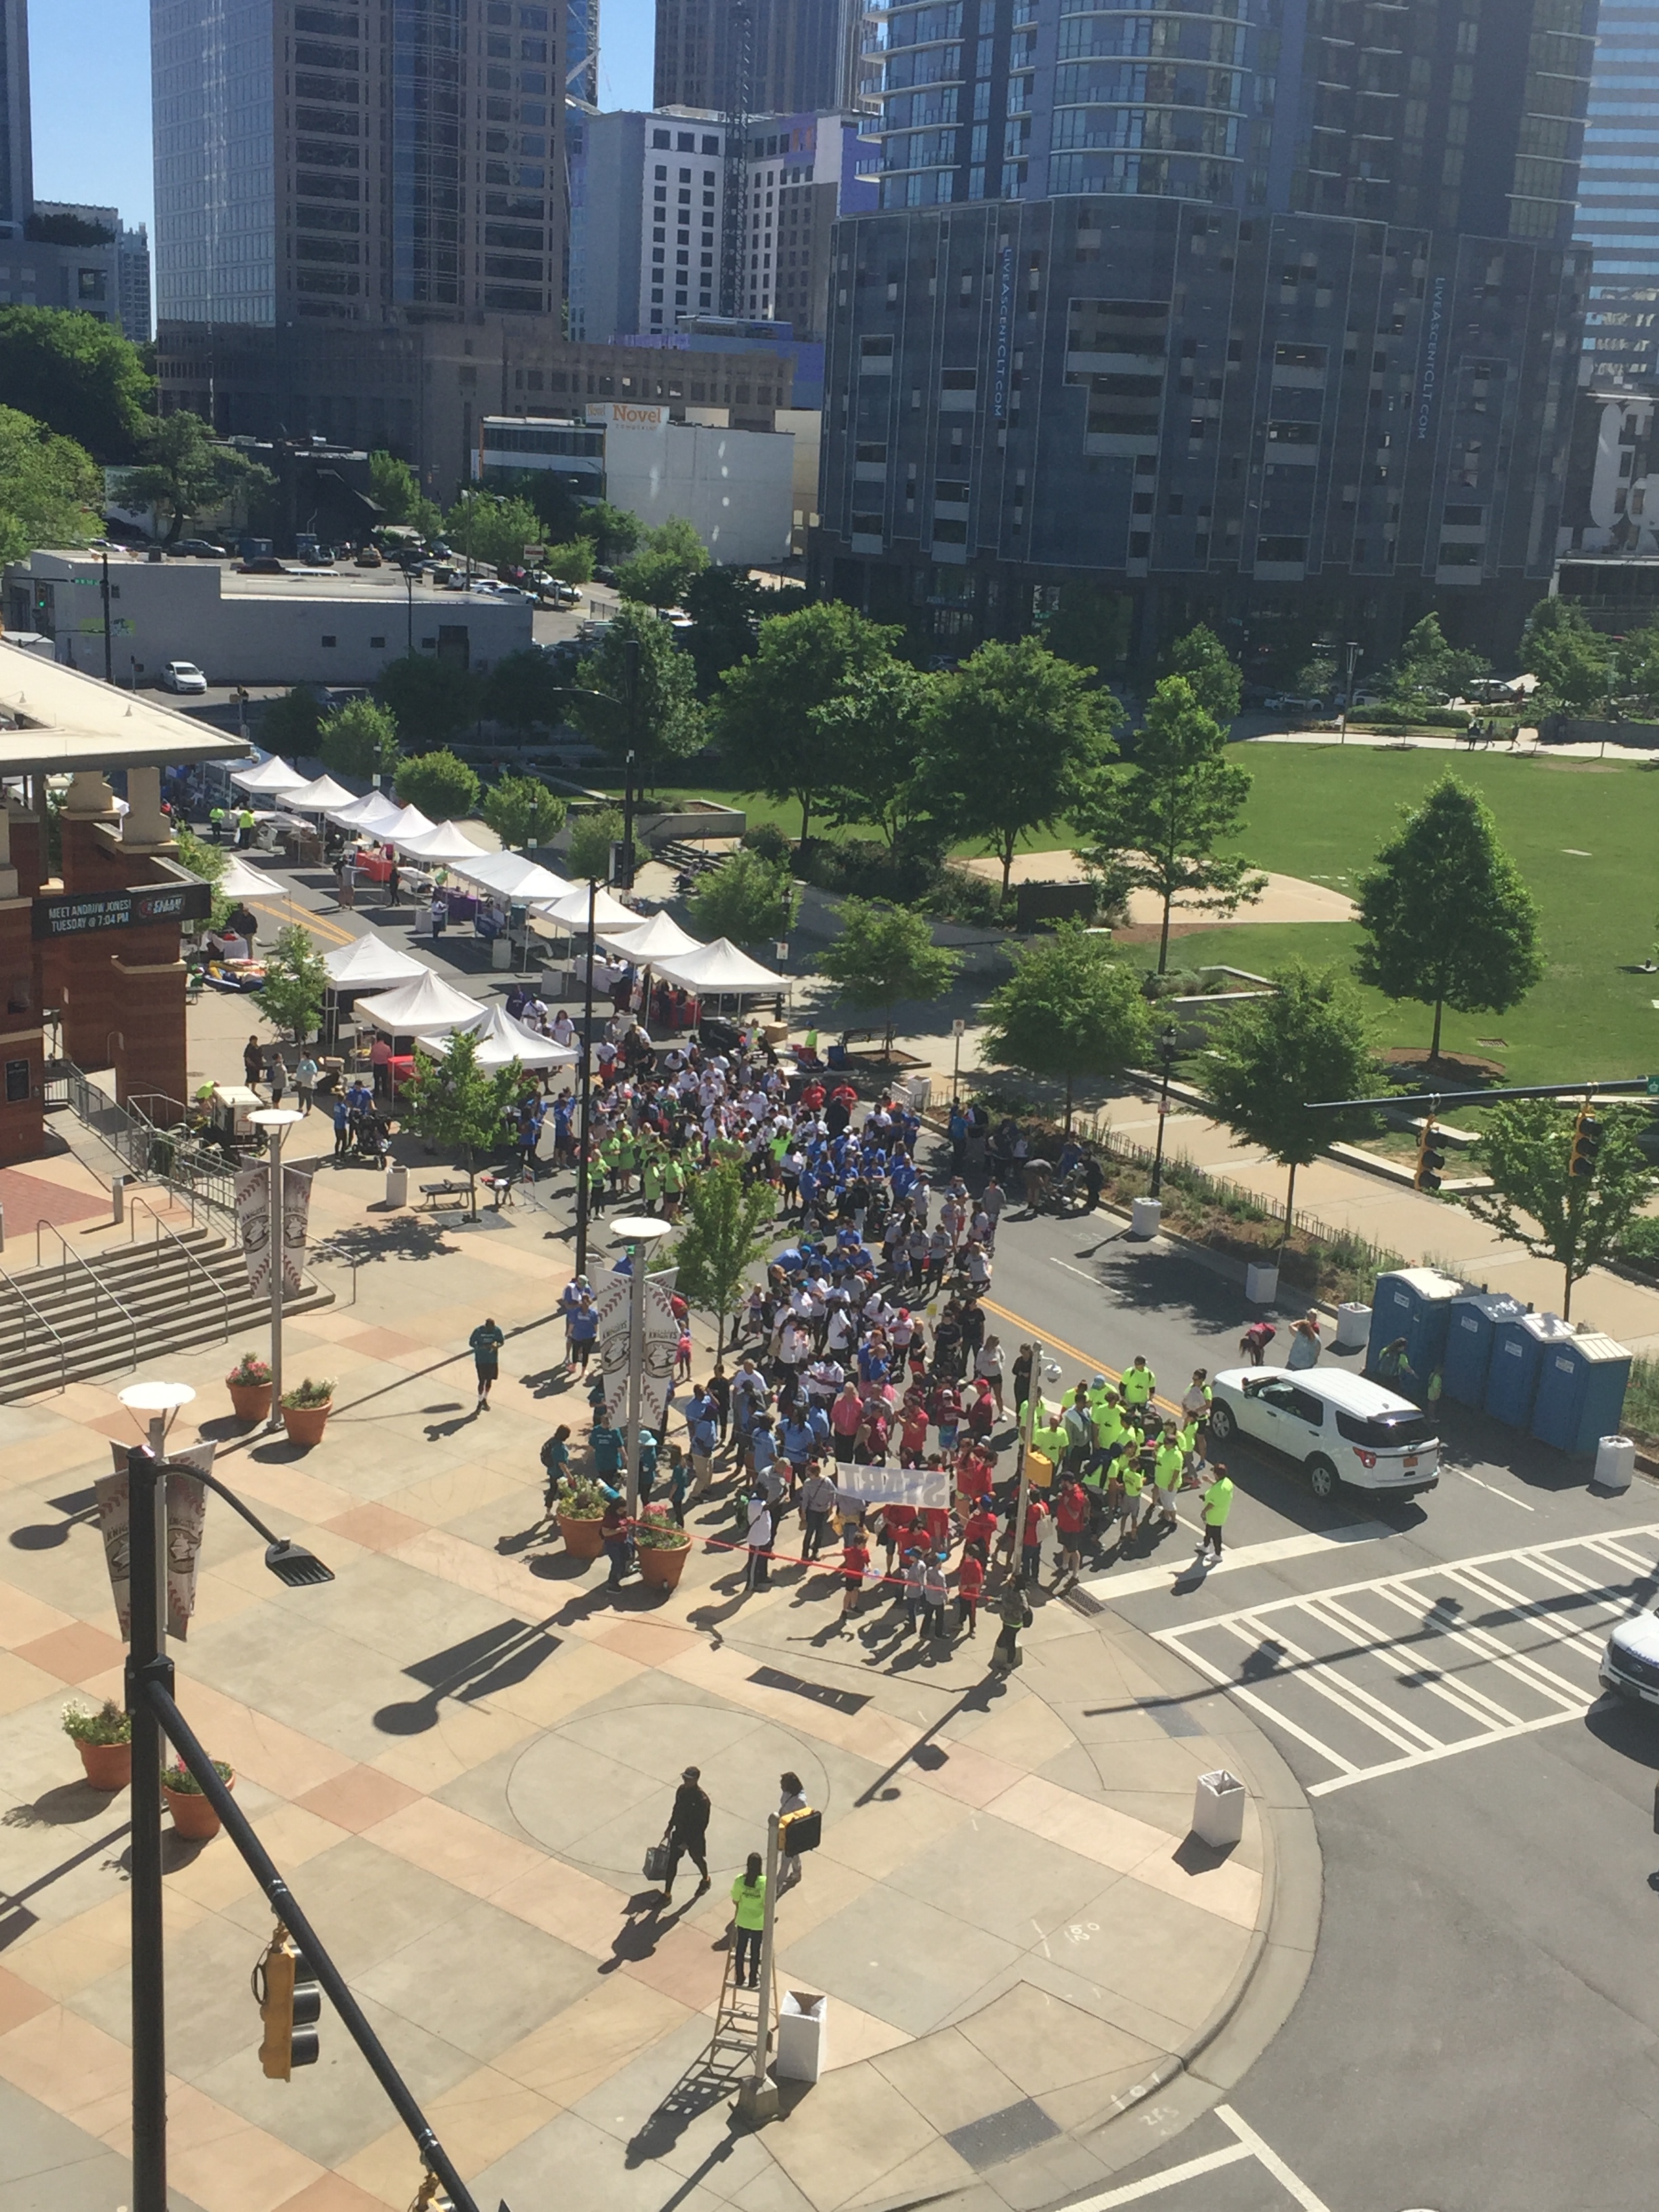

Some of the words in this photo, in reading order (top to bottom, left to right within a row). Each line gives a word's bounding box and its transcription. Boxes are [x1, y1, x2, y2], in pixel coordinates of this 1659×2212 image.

[613, 405, 661, 424] Novel
[49, 906, 70, 920] MEET
[71, 902, 105, 916] ANDRUW
[52, 917, 87, 933] TUESDAY
[88, 918, 96, 928] @
[98, 914, 115, 926] 7:04
[117, 912, 129, 923] PM
[106, 1523, 128, 1542] KNIG
